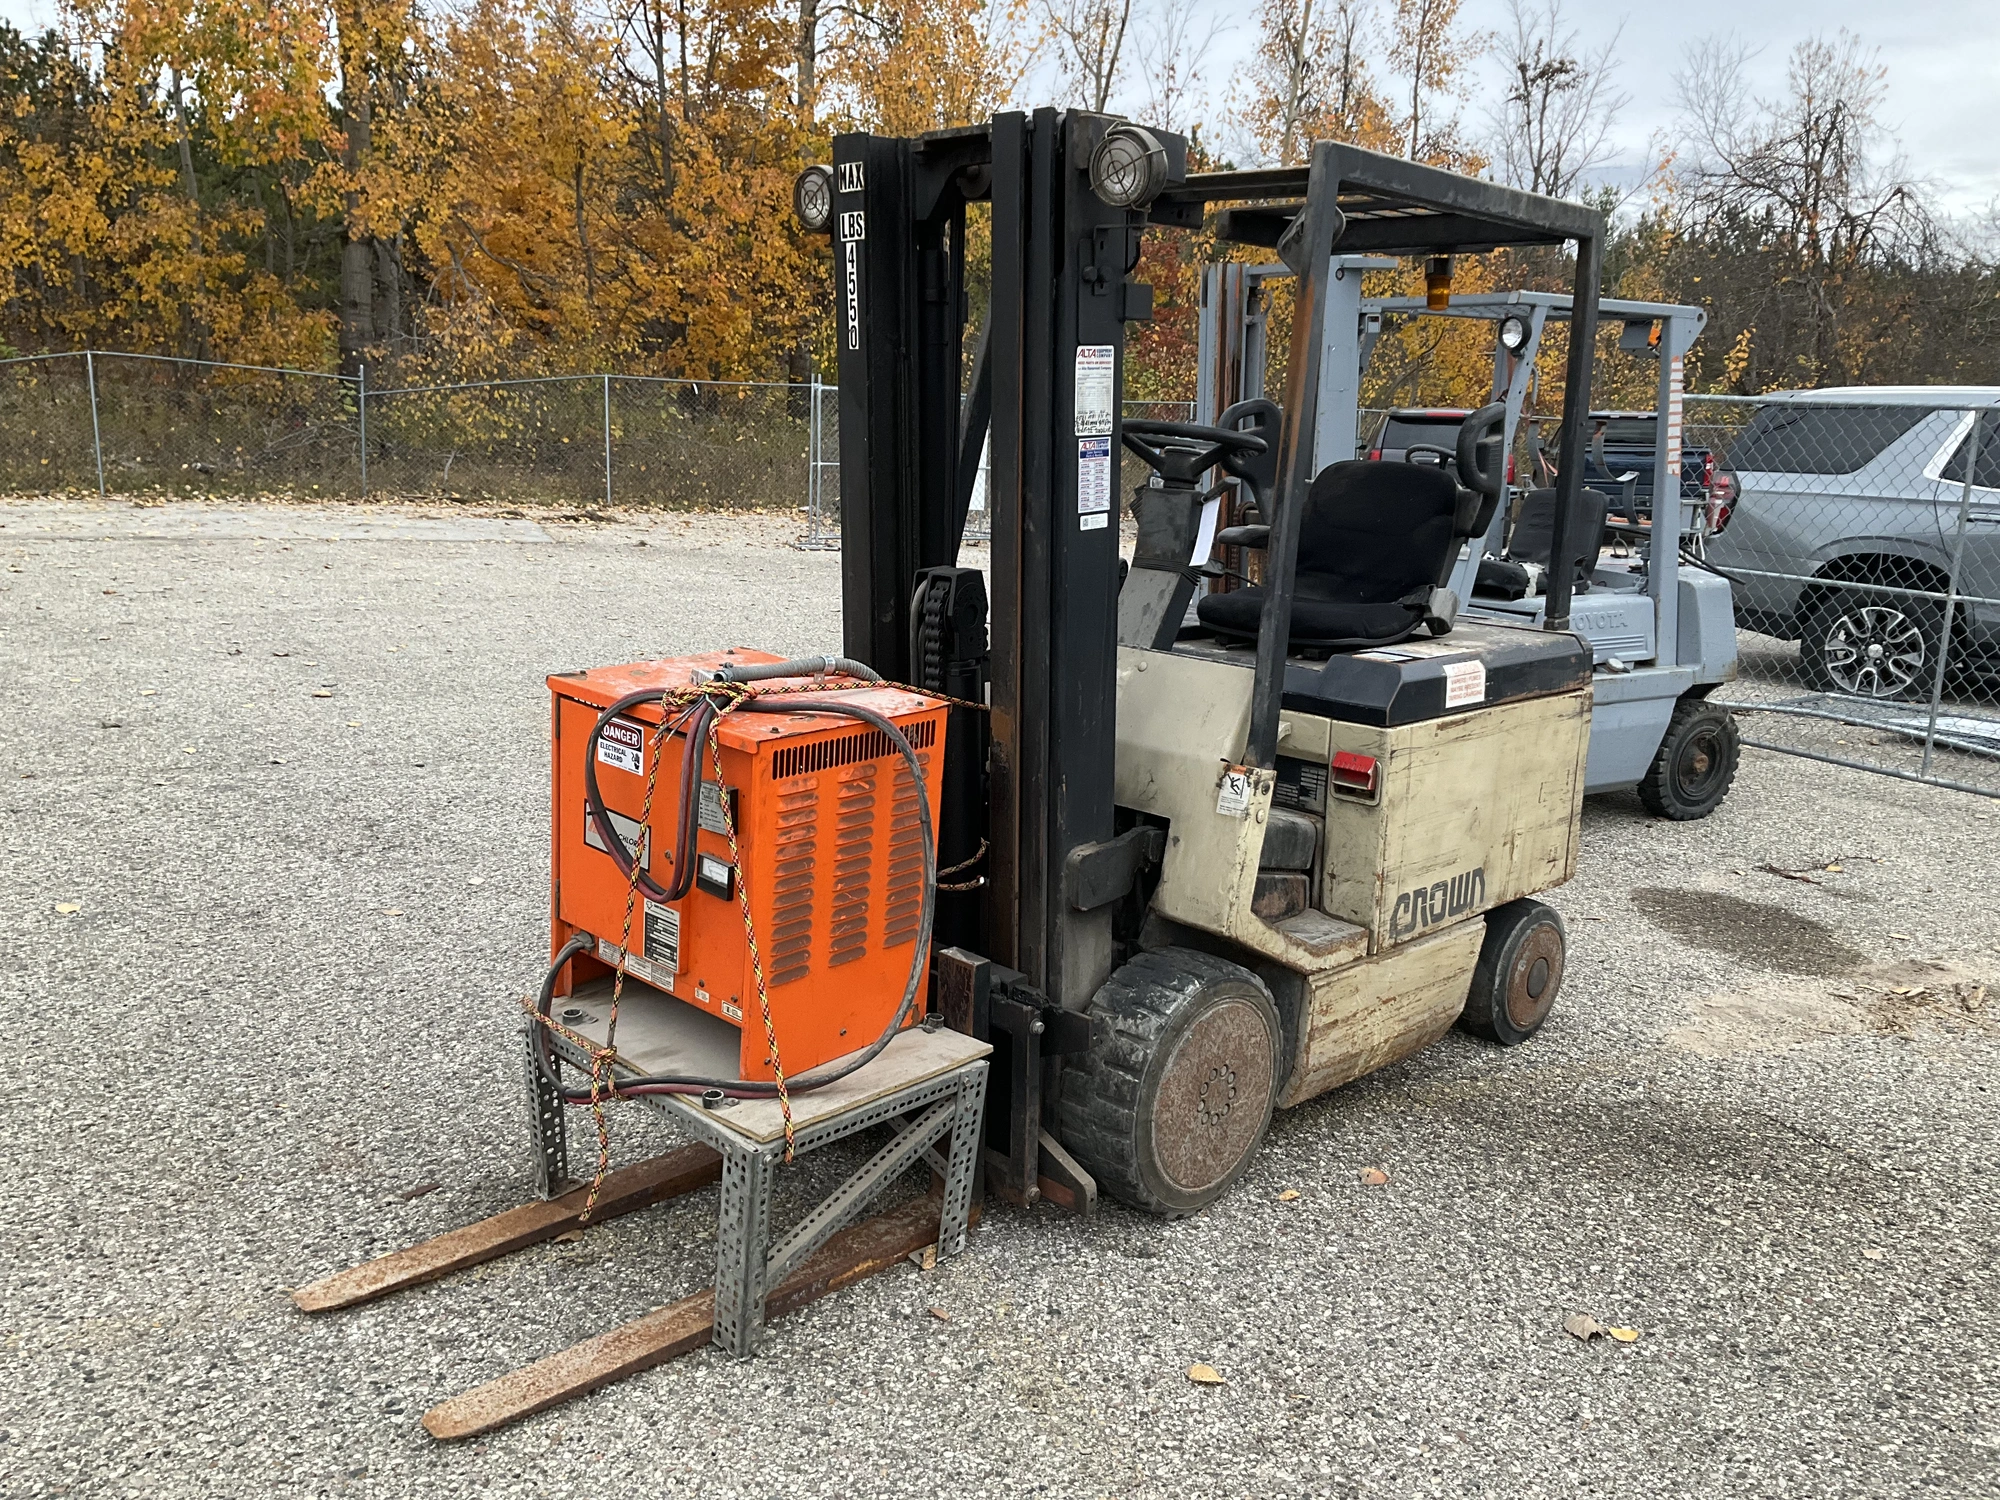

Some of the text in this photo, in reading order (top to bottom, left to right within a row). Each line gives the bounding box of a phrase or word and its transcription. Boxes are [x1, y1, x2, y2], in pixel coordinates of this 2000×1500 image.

[839, 163, 864, 191] MAX
[841, 213, 863, 240] LBS
[848, 244, 858, 348] 4550
[1077, 349, 1096, 358] ALTA
[1081, 441, 1096, 450] ALTA
[603, 724, 638, 746] DANGER
[600, 742, 627, 757] ELECTRICAL
[604, 751, 623, 763] HAZARD
[1388, 867, 1485, 940] CROWN
